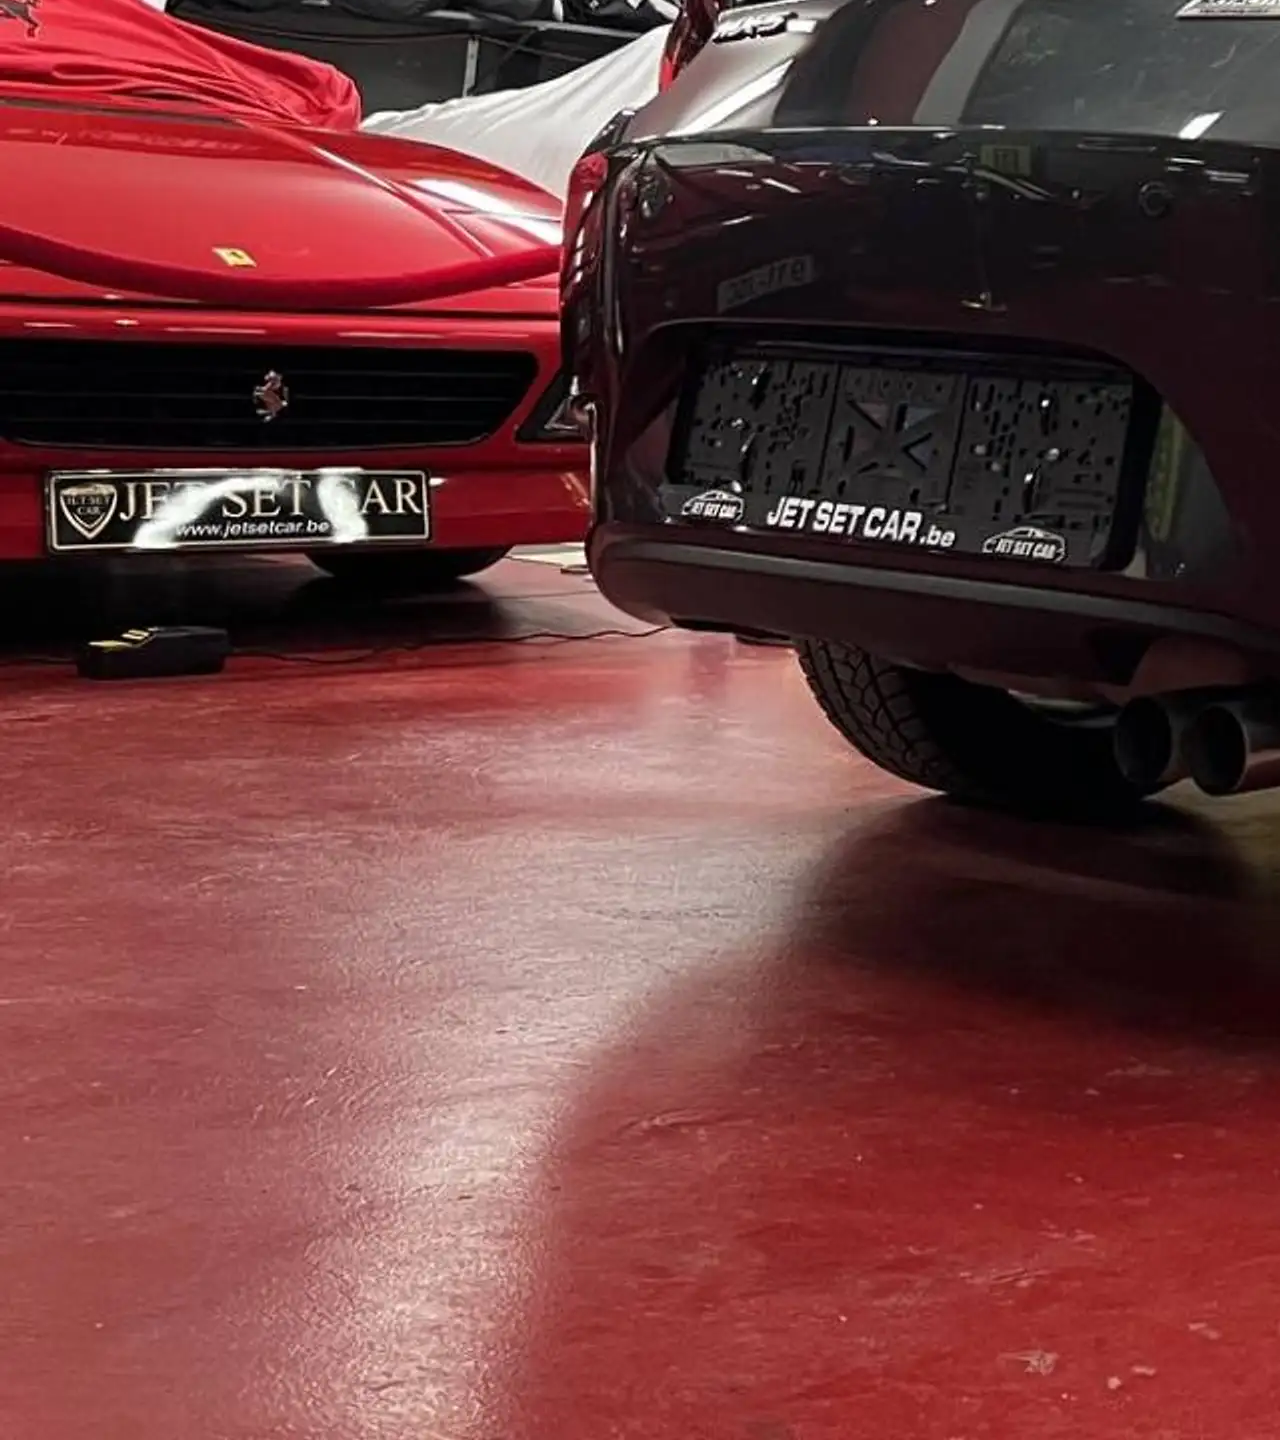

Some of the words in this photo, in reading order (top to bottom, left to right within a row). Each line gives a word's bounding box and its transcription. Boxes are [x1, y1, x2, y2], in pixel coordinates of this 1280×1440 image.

[174, 519, 330, 539] www.jetsetcar.be
[766, 496, 815, 530] JET
[812, 501, 866, 536] SET
